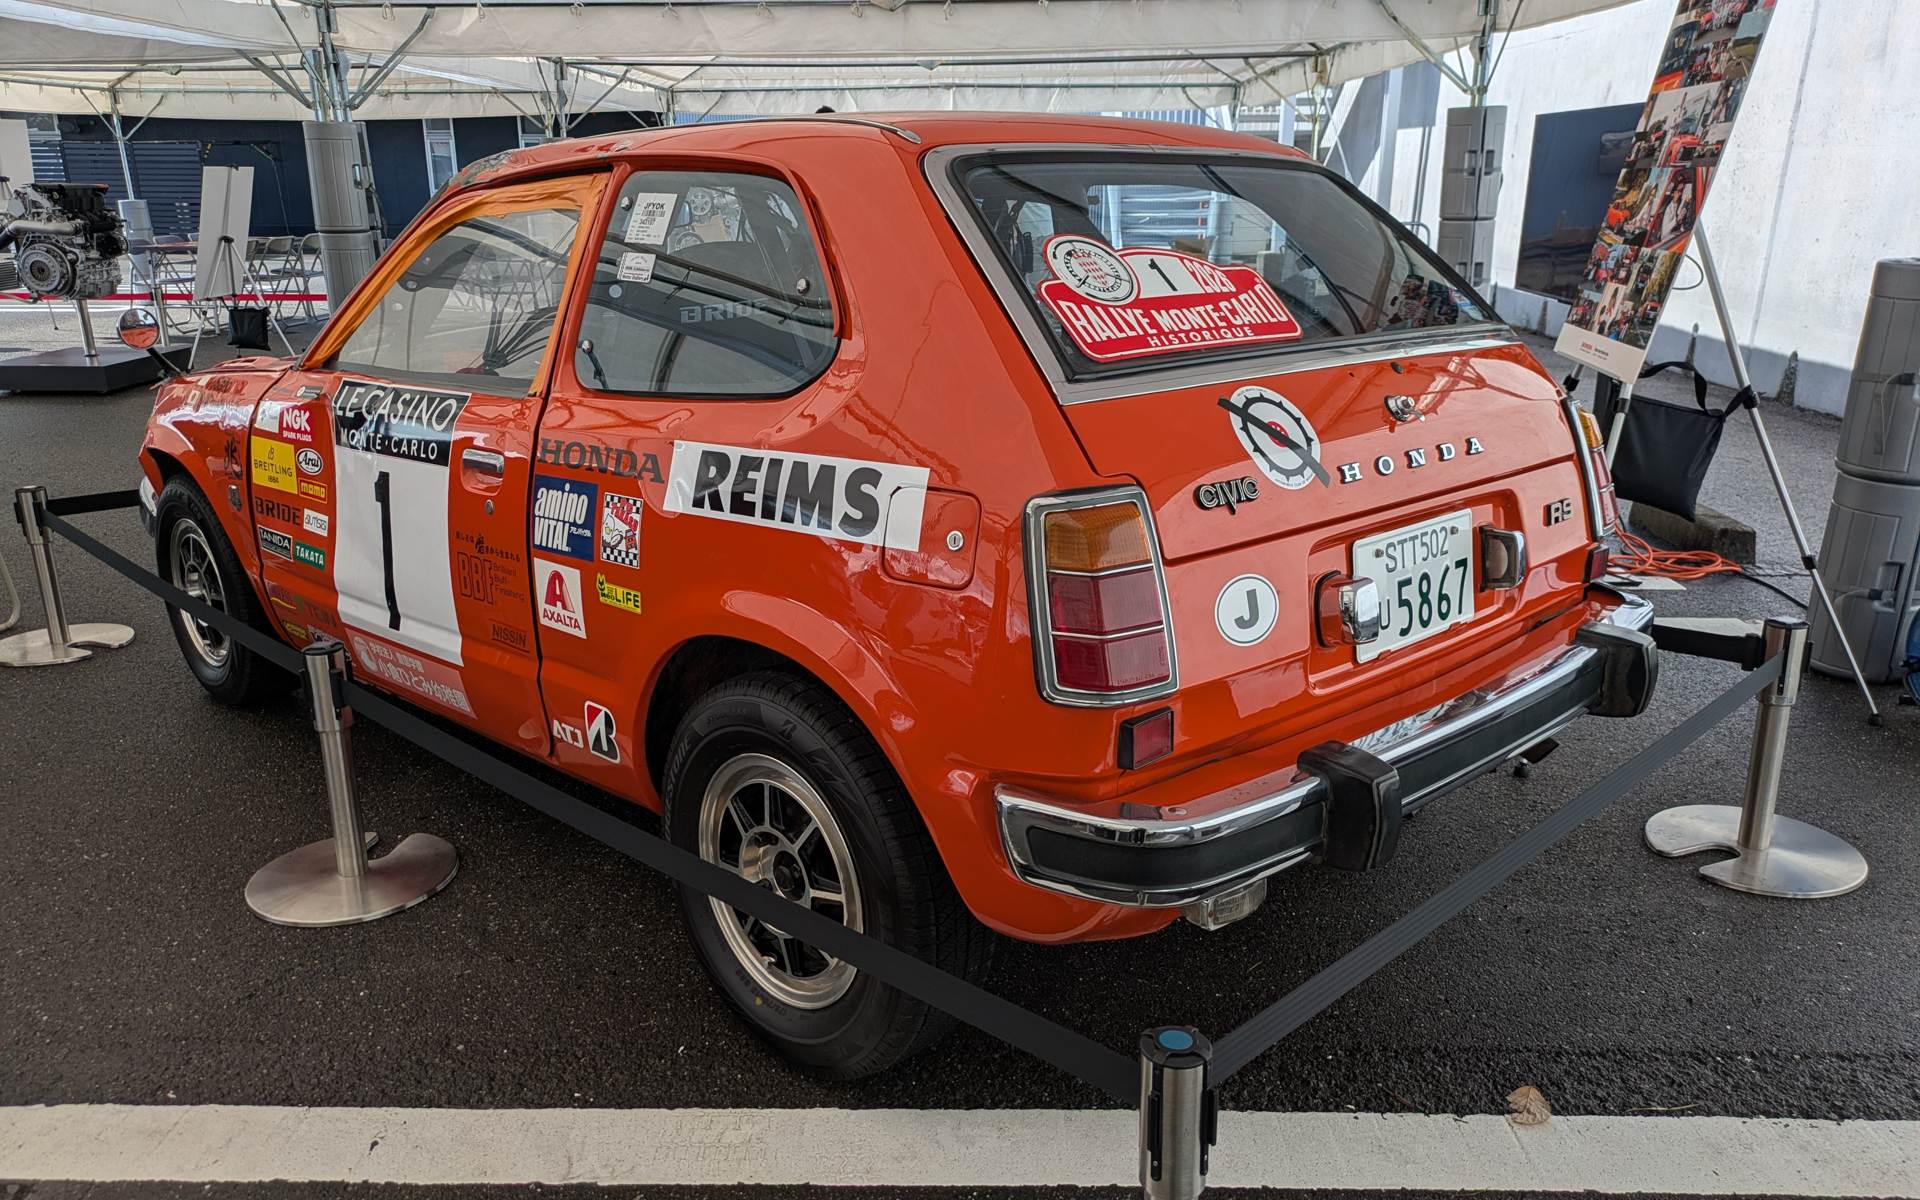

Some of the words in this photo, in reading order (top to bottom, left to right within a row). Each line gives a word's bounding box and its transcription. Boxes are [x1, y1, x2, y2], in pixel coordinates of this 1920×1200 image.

[1148, 258, 1179, 292] 1
[1183, 258, 1237, 294] 2026
[1056, 300, 1157, 344] RALLYE
[1150, 284, 1289, 334] MONTE-CARLO
[1147, 326, 1256, 348] HISTORIQUE
[283, 408, 311, 432] NGK
[336, 385, 366, 418] LE
[362, 390, 458, 432] CASINO
[283, 430, 297, 440] SPARK
[296, 432, 312, 442] PLUGS
[254, 459, 293, 478] BREITLING
[299, 452, 320, 469] Arai
[537, 437, 665, 484] HONDA
[1339, 437, 1485, 484] HONDA
[267, 475, 280, 484] 1884
[691, 449, 883, 538] REIMS
[1197, 476, 1261, 514] CIVIC
[255, 496, 301, 526] BRIDE
[534, 482, 589, 525] amino
[1547, 498, 1572, 527] RS
[259, 528, 291, 550] TANIDA
[534, 516, 571, 552] VITAL
[1385, 525, 1449, 573] STT502
[296, 545, 324, 566] TAKATA
[374, 470, 401, 632] 1
[457, 551, 494, 605] BBF
[493, 562, 517, 577] Brilliant
[494, 584, 525, 603] Finishing
[1234, 588, 1260, 630] J
[1397, 557, 1469, 637] 5867
[304, 602, 338, 630] TEIN
[542, 607, 582, 632] AXALTA
[492, 624, 527, 647] NISSIN
[378, 658, 471, 712] 小倉ひとみ幼稚園
[707, 707, 749, 725] STUDLESS
